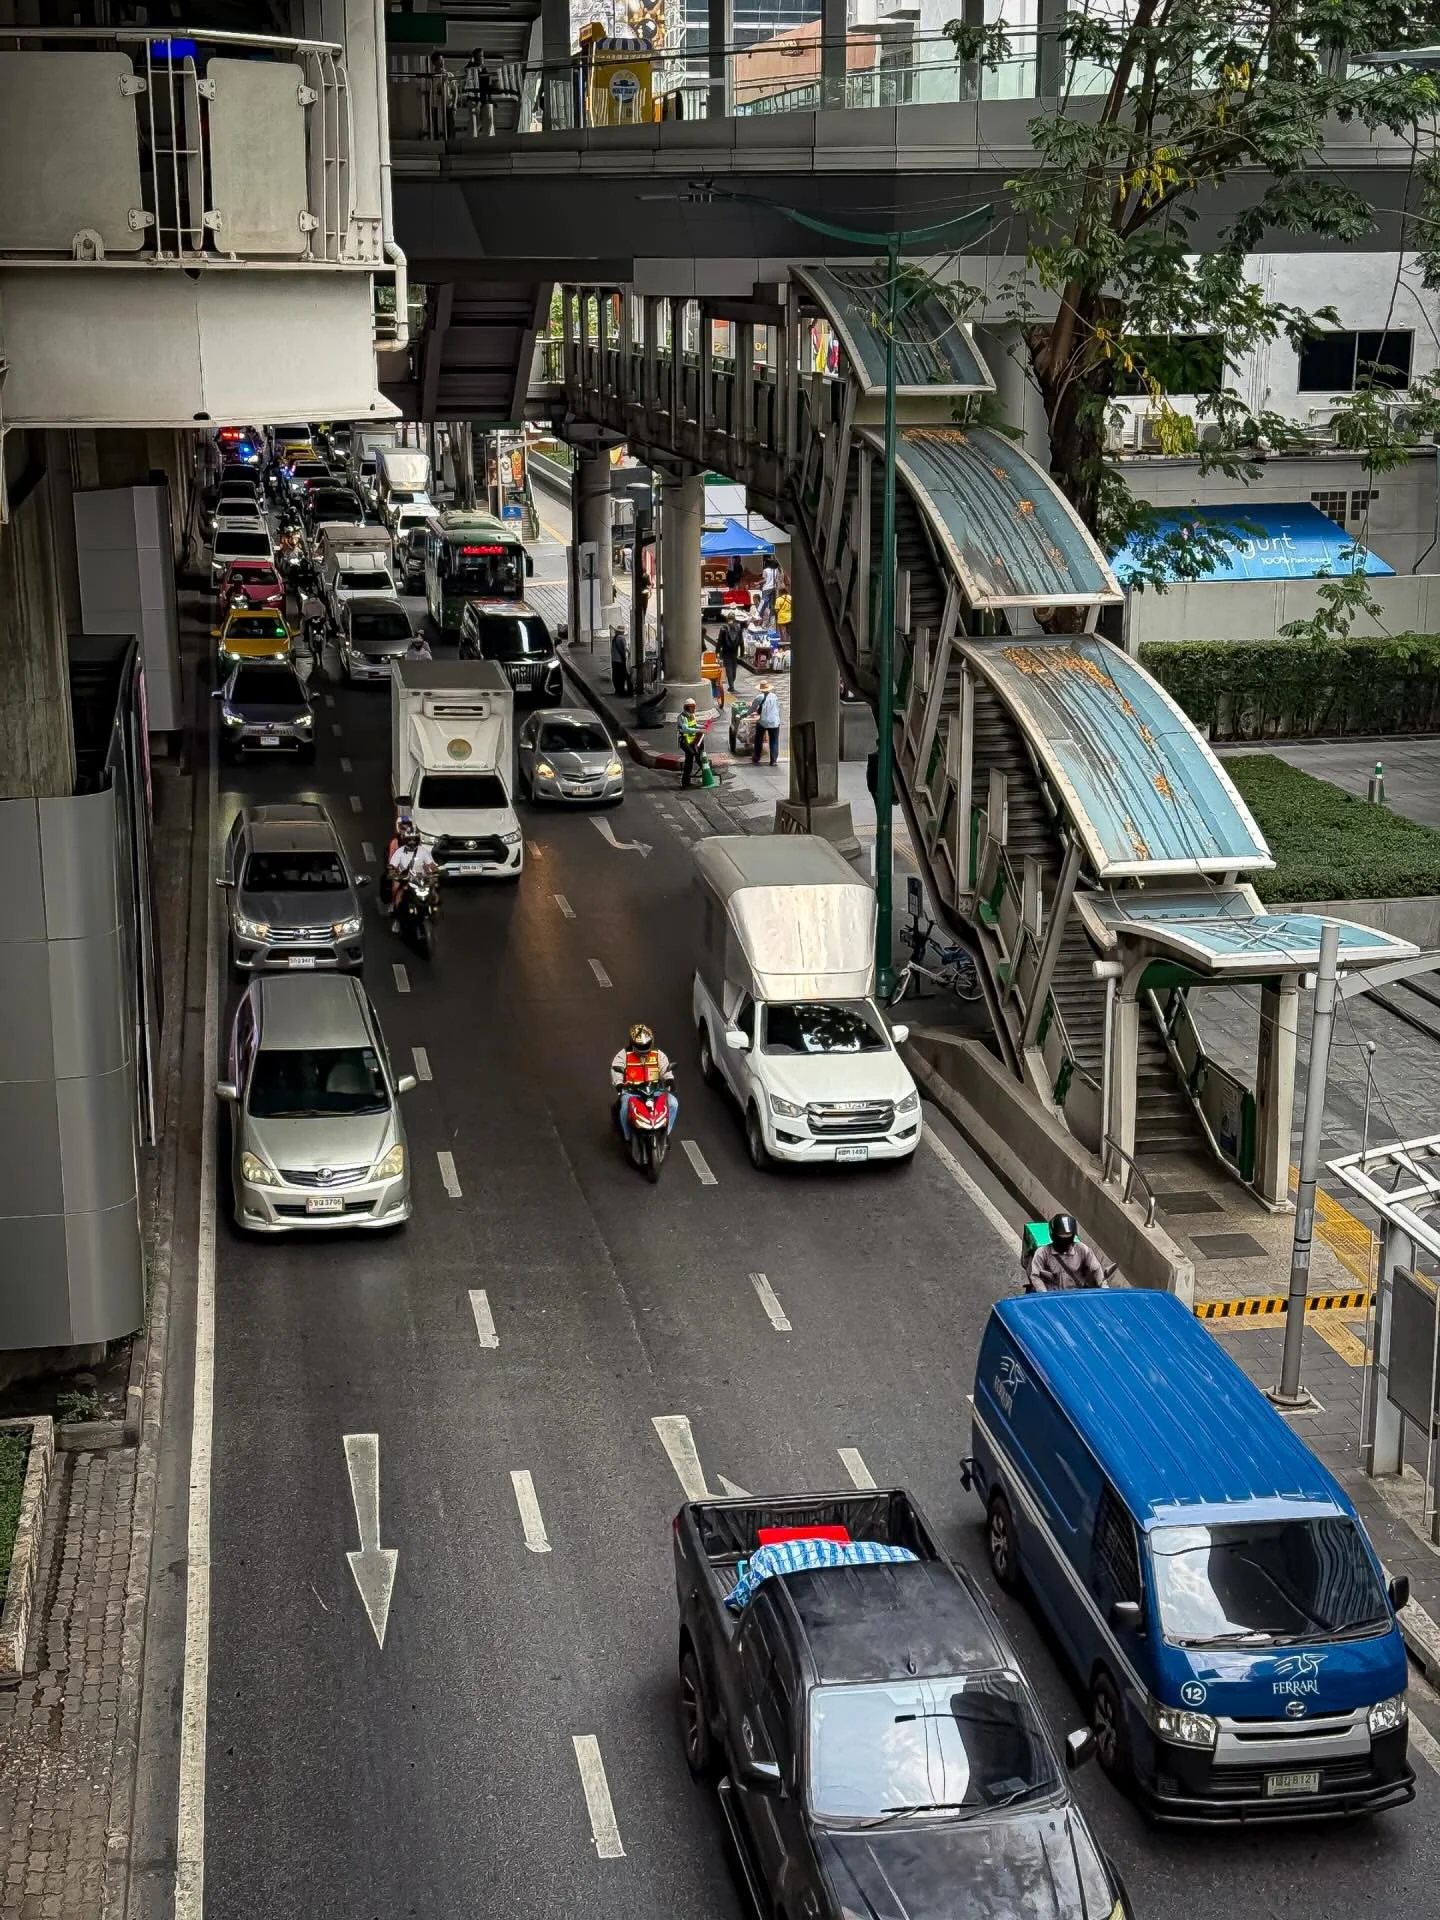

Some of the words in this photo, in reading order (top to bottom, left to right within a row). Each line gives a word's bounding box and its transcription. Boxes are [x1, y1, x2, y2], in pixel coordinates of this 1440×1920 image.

[1261, 556, 1288, 565] 100%
[1185, 1687, 1202, 1700] 12
[1272, 1680, 1320, 1697] FERRARI
